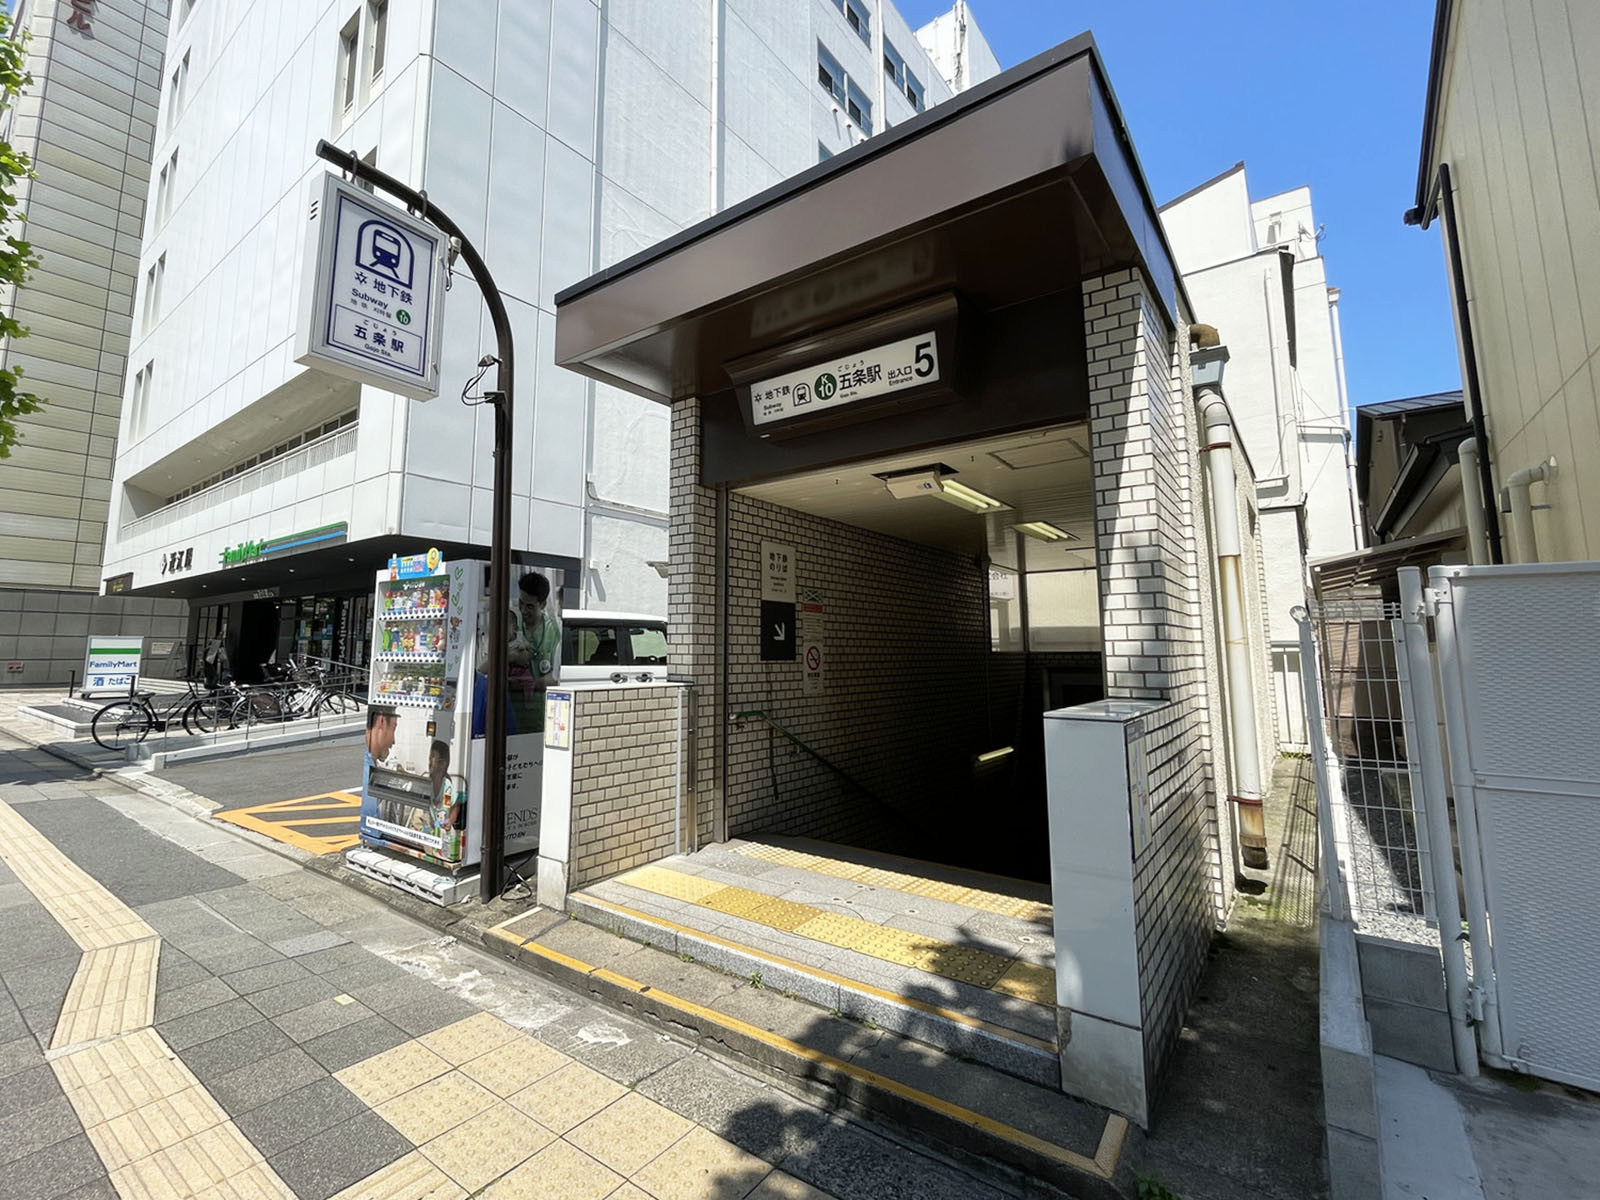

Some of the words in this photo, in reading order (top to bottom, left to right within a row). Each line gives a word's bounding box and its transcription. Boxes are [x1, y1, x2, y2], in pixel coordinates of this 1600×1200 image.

[351, 288, 388, 310] Subway
[373, 278, 413, 305] 地下鉄
[353, 324, 405, 354] 五条駅
[914, 341, 935, 377] 5
[821, 375, 829, 385] K
[839, 364, 882, 391] 五条駅
[888, 366, 912, 380] 出入口
[888, 376, 913, 386] Entrance
[765, 385, 791, 400] 地下鉄
[818, 382, 834, 398] 10
[89, 660, 137, 668] FamilyMart
[92, 676, 105, 686] 酒
[108, 677, 131, 685] たばこ
